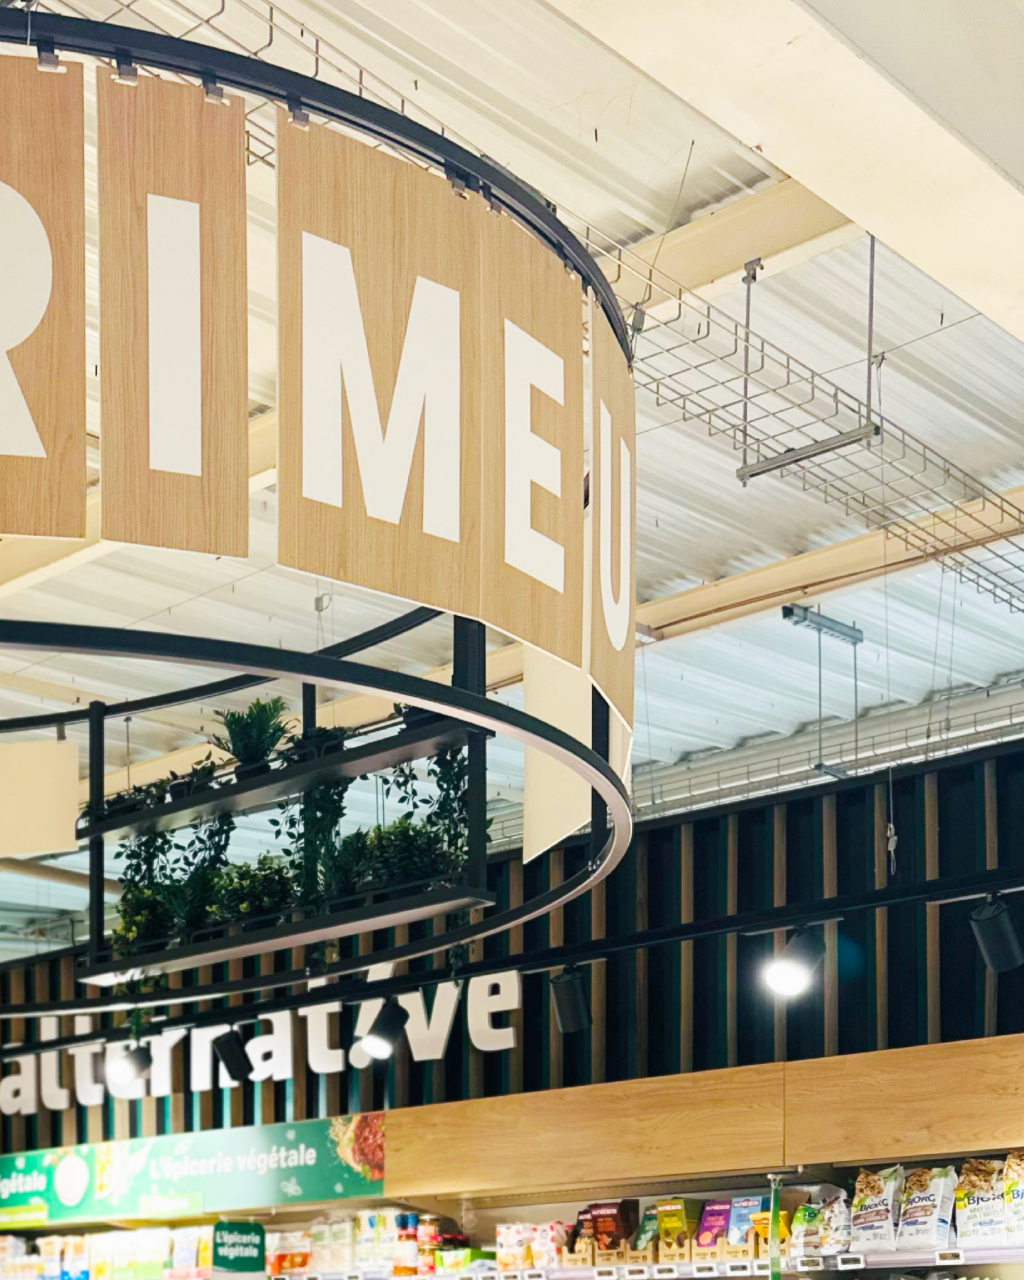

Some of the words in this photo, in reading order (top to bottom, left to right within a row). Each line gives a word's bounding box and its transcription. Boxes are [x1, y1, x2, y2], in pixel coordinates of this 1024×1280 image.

[237, 1143, 317, 1174] végétale
[216, 1231, 261, 1246] L'épicerie
[217, 1244, 259, 1260] végétale
